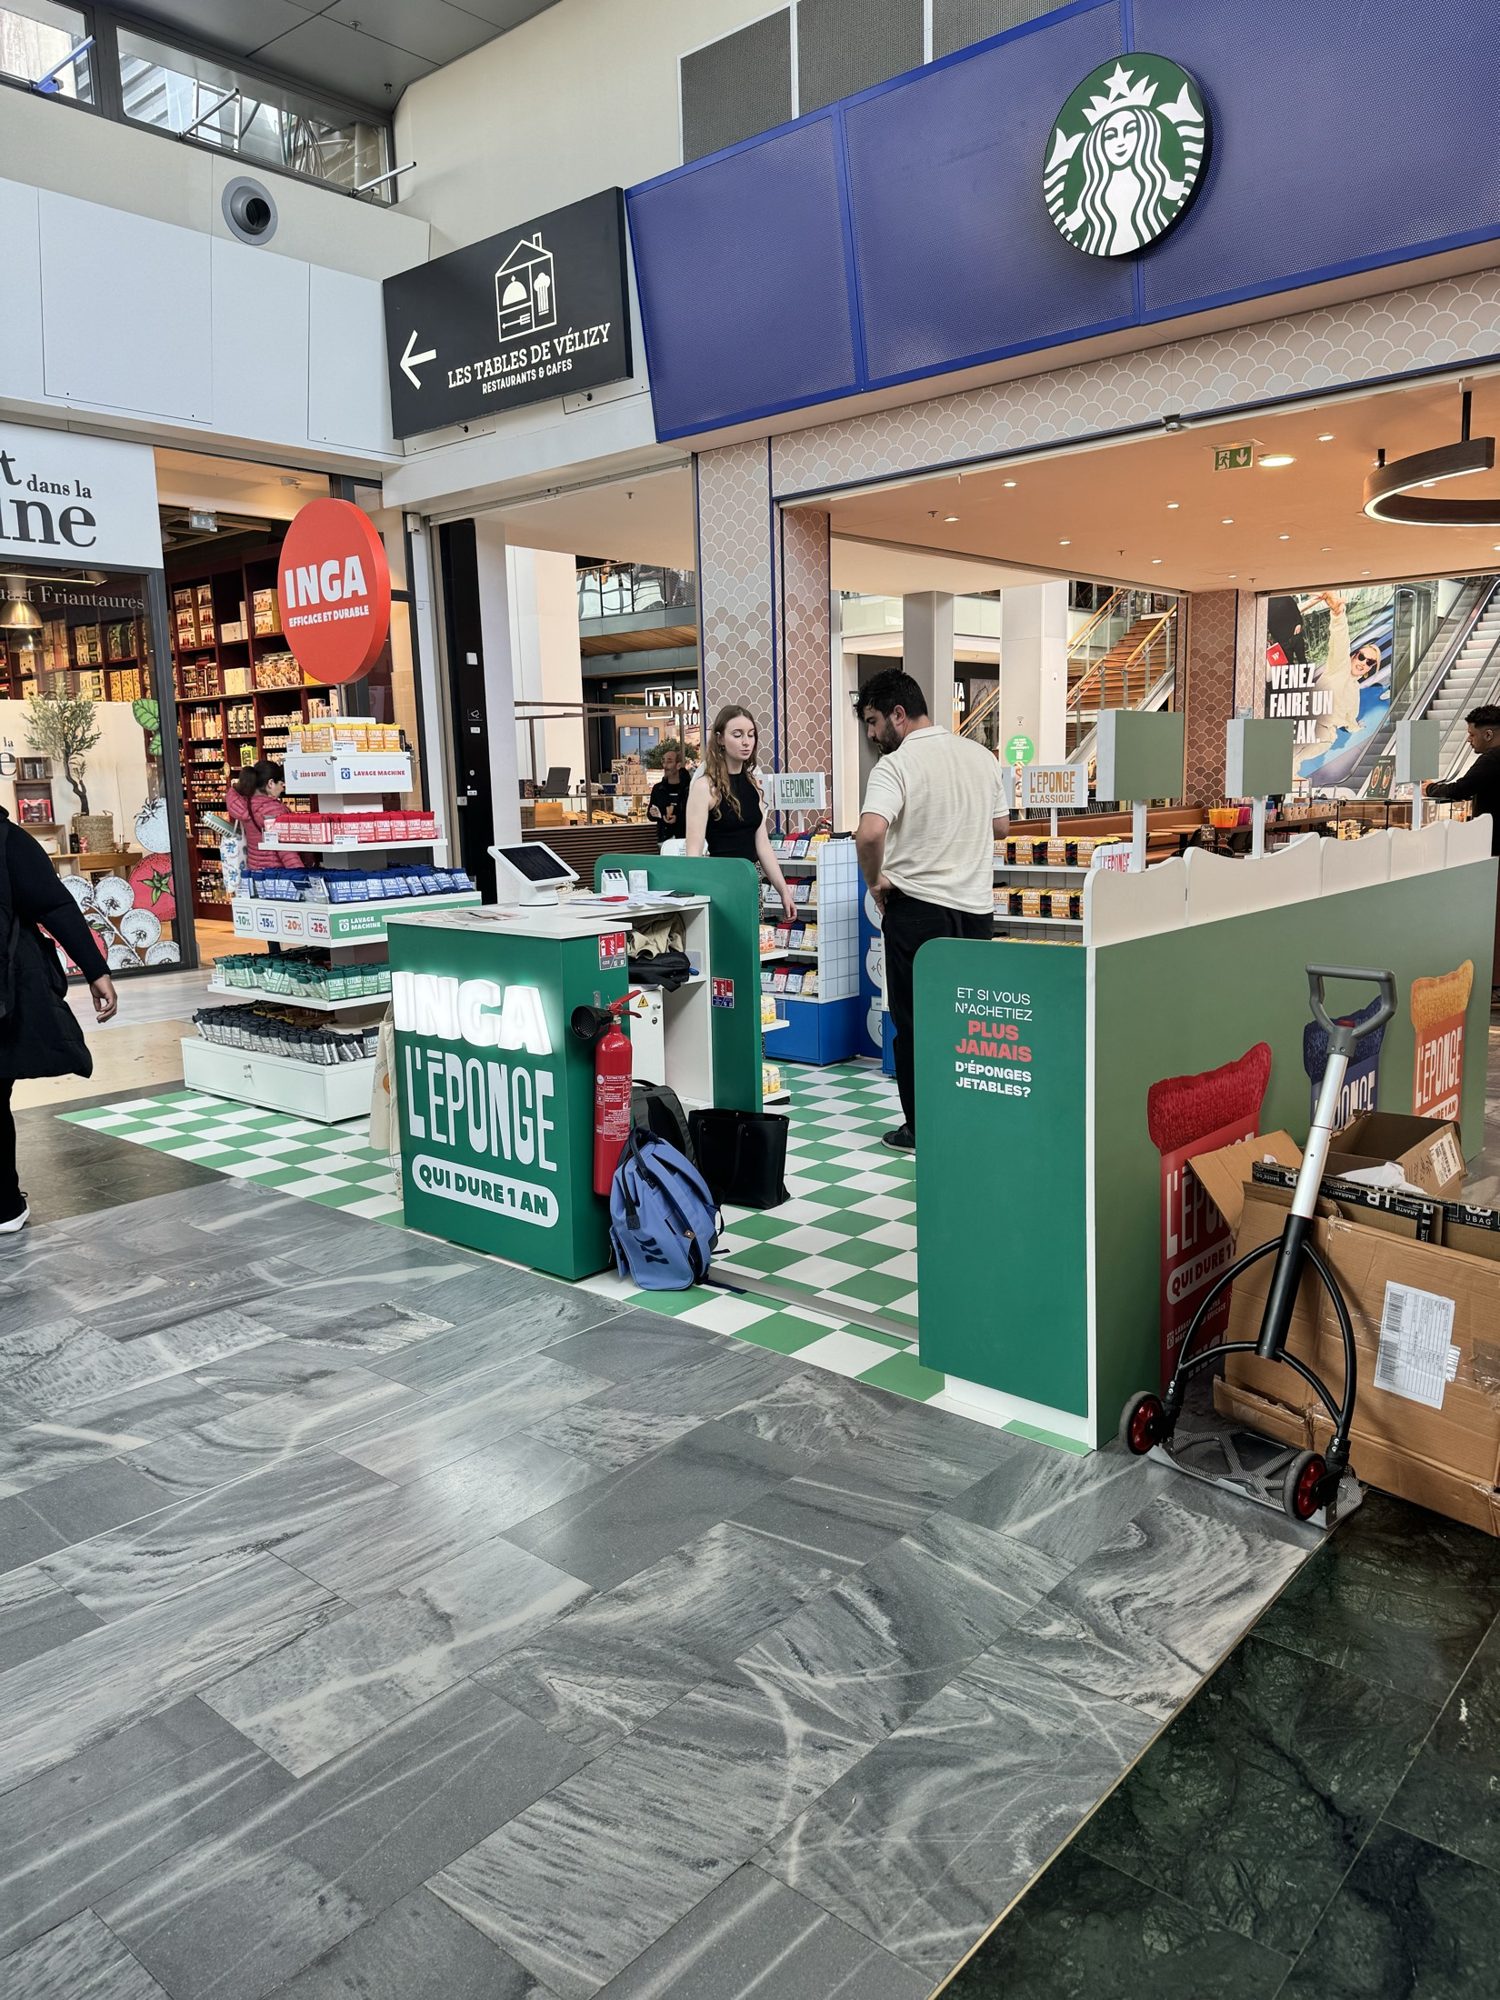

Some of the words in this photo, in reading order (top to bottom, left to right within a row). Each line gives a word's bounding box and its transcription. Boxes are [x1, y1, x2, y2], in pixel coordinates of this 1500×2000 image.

[447, 365, 472, 388] LES
[473, 348, 528, 380] TABLES
[530, 340, 551, 365] DE
[553, 322, 611, 356] VÉLIZY
[482, 368, 537, 395] RESTAURANTS
[538, 367, 545, 378] &
[546, 358, 573, 377] CAFES
[26, 474, 70, 496] dans
[74, 480, 92, 499] la
[284, 555, 368, 609] INGA
[40, 585, 145, 609] Friantaures
[288, 612, 323, 628] EFFICACE
[323, 611, 333, 622] ET
[333, 605, 370, 620] DURABLE
[1271, 663, 1316, 690] VENEZ
[1269, 691, 1309, 718] FAIRE
[1312, 690, 1333, 715] UN
[1030, 794, 1076, 803] CLASSIQUE
[259, 918, 275, 929] -15%
[285, 920, 302, 931] -20%
[311, 922, 328, 934] -25%
[350, 916, 375, 924] LAVAGE
[351, 922, 381, 931] MACHINE
[957, 987, 974, 999] ET
[977, 989, 989, 1001] SI
[993, 991, 1031, 1005] VOUS
[391, 971, 553, 1056] INGA
[955, 1002, 1033, 1021] N'ACHETIEZ
[968, 1020, 1019, 1041] PLUS
[955, 1038, 1032, 1062] JAMAIS
[955, 1060, 1032, 1082] D'ÉPONGES
[956, 1077, 1031, 1098] JETABLES?
[420, 1164, 451, 1188] QUI
[454, 1172, 504, 1208] DURE
[507, 1188, 516, 1207] 1
[520, 1191, 549, 1217] AN
[1395, 1206, 1418, 1216] ARANTIE
[1171, 1270, 1194, 1296] QUI
[1195, 1254, 1223, 1277] DURE
